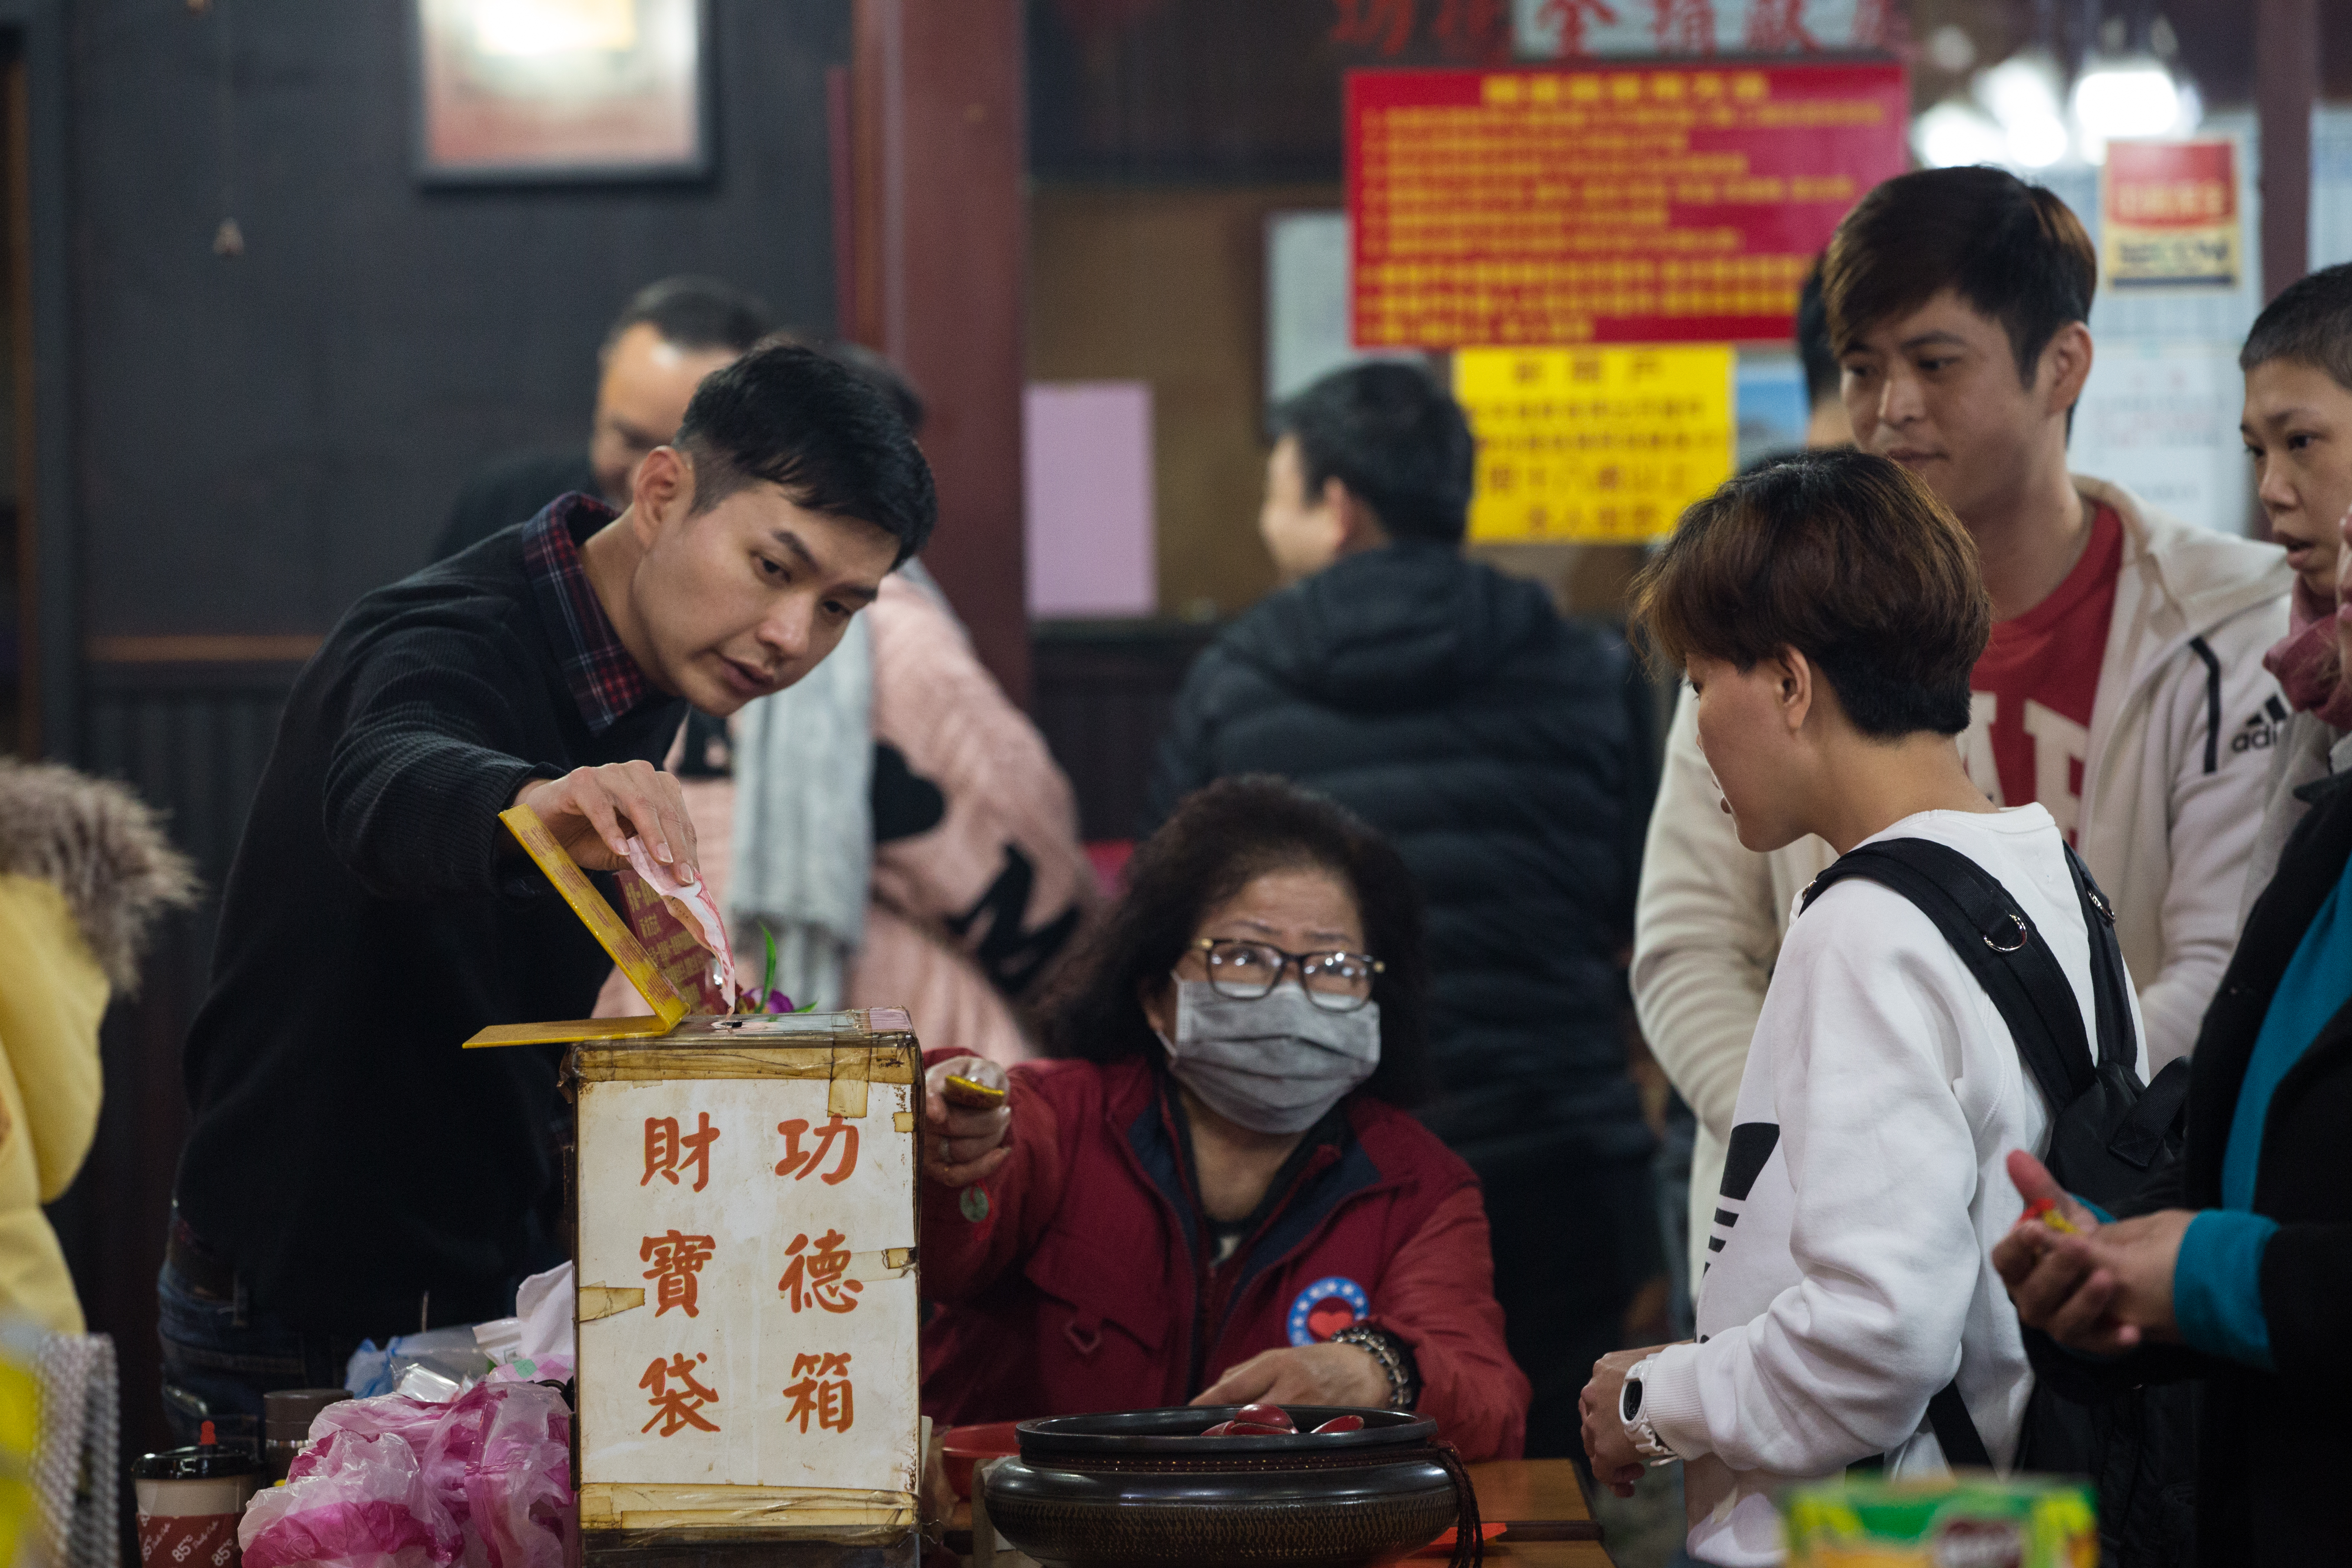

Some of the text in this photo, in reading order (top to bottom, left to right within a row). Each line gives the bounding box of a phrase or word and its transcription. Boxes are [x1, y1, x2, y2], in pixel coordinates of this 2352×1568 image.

[639, 1112, 720, 1437] 財寶袋
[775, 1114, 863, 1434] 功德箱
